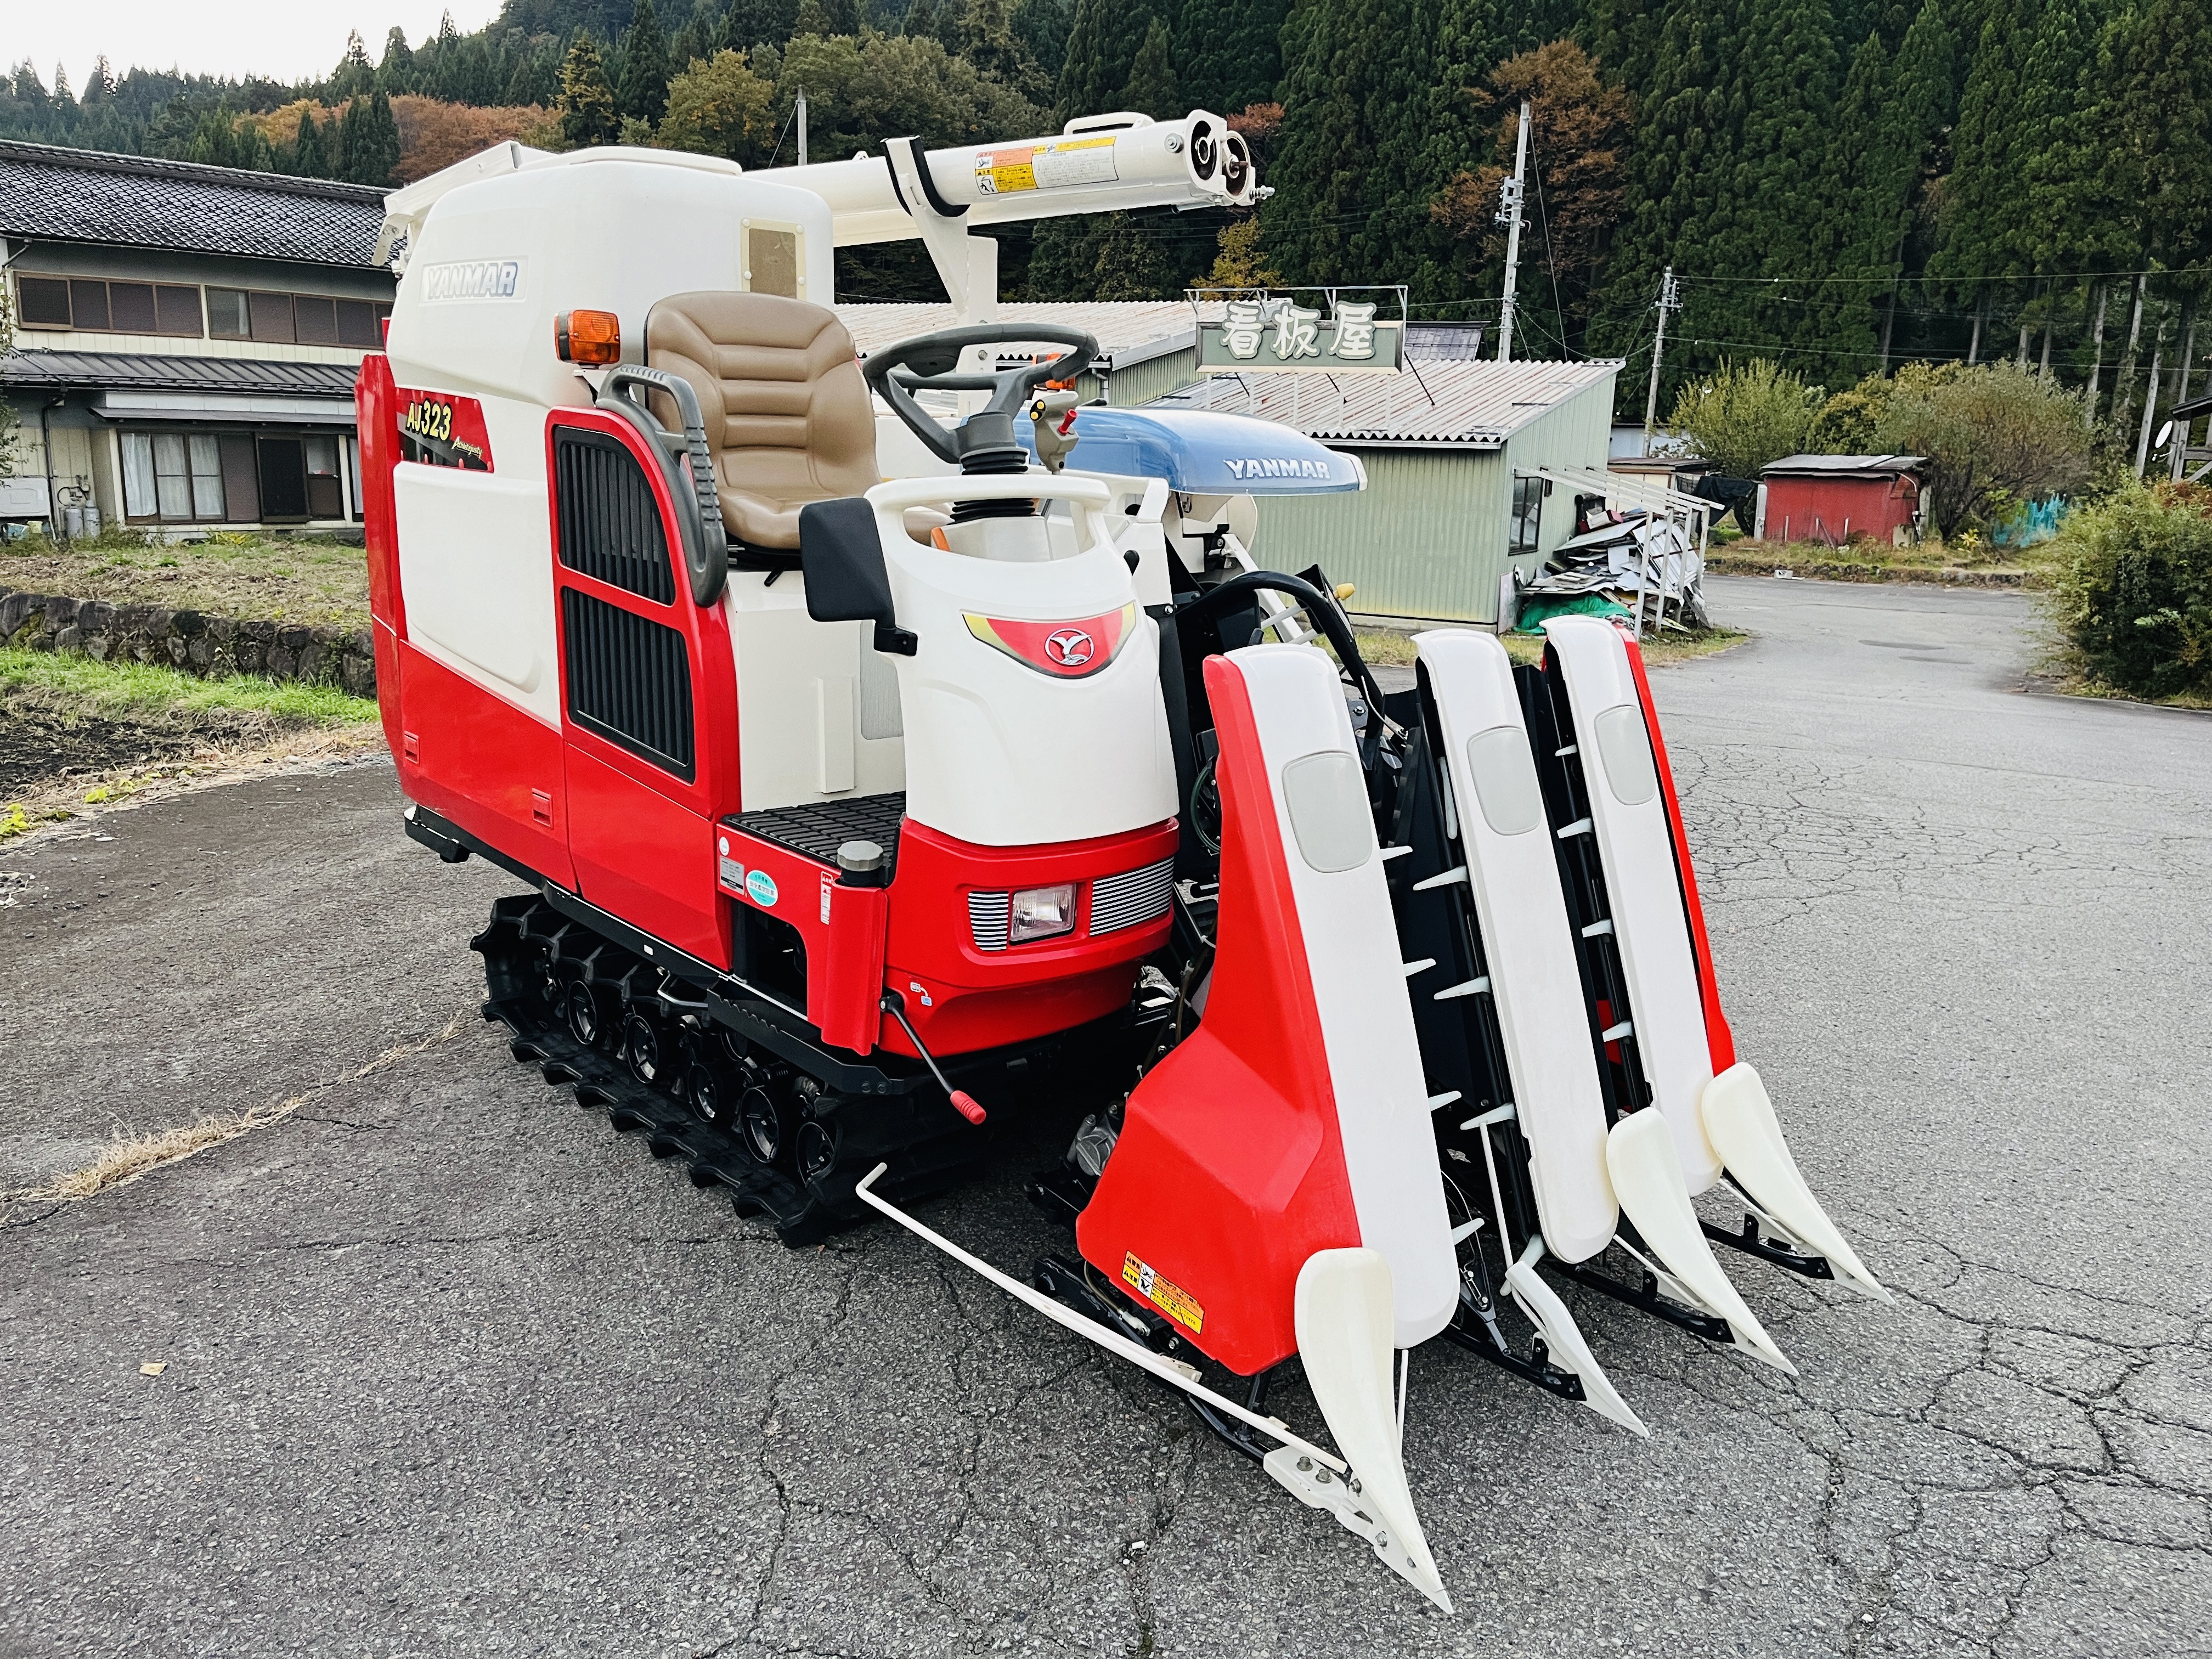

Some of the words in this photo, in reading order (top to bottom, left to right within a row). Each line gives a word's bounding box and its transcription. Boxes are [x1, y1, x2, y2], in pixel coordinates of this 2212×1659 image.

[428, 262, 518, 300] YANMAR
[1222, 303, 1376, 357] 看板屋
[406, 399, 452, 441] AJ323
[1223, 458, 1331, 479] YANMAR
